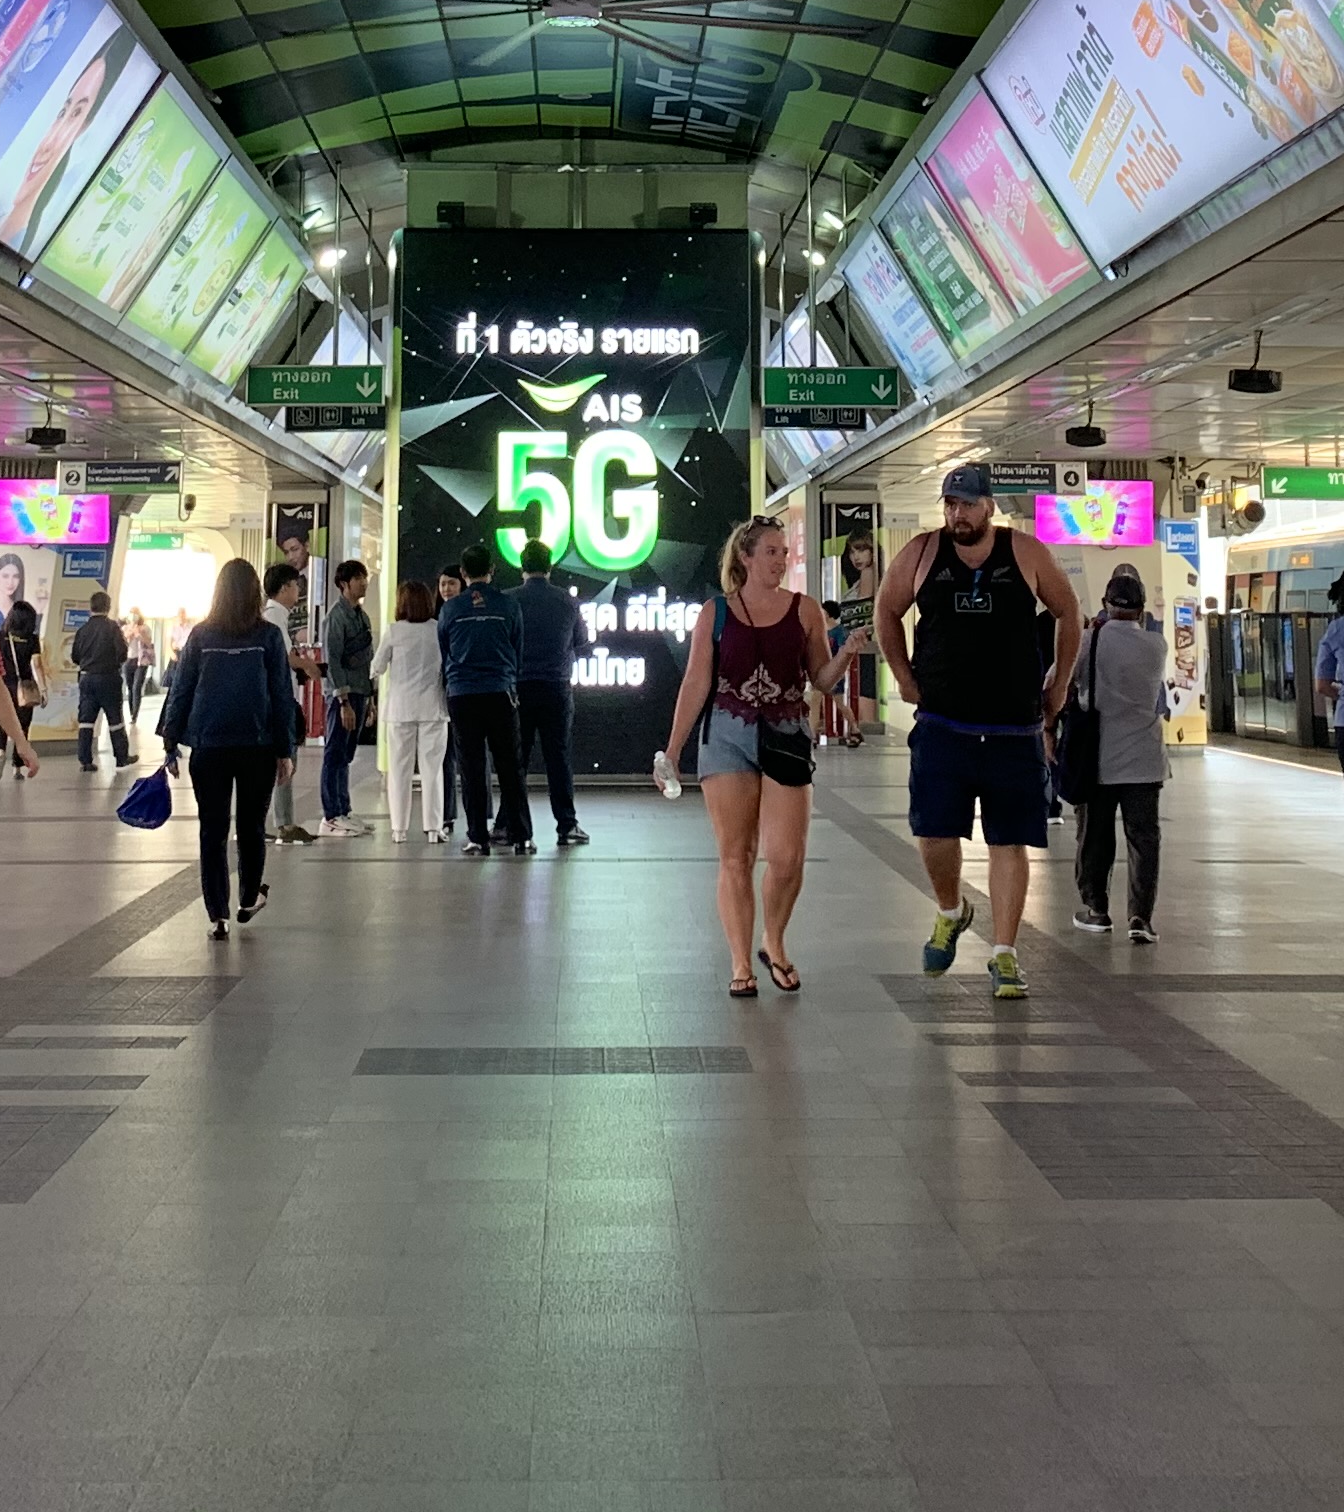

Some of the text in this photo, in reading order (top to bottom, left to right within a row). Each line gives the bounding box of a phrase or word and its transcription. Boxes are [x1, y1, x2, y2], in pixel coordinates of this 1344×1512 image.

[1049, 3, 1115, 159] เนสกาแฟ ลาเต้
[455, 311, 701, 355] ที่ 1 ตัวจริง รายแรก
[272, 371, 331, 384] ทางออก
[786, 371, 847, 385] ทางออก
[273, 388, 300, 400] Exit
[788, 389, 815, 402] Exit
[582, 393, 644, 424] AIS
[998, 477, 1024, 485] National
[1025, 477, 1050, 485] Stadium
[495, 428, 660, 572] 5G
[295, 511, 313, 520] AIS
[854, 511, 871, 520] AIS
[63, 552, 103, 576] Lactasoy
